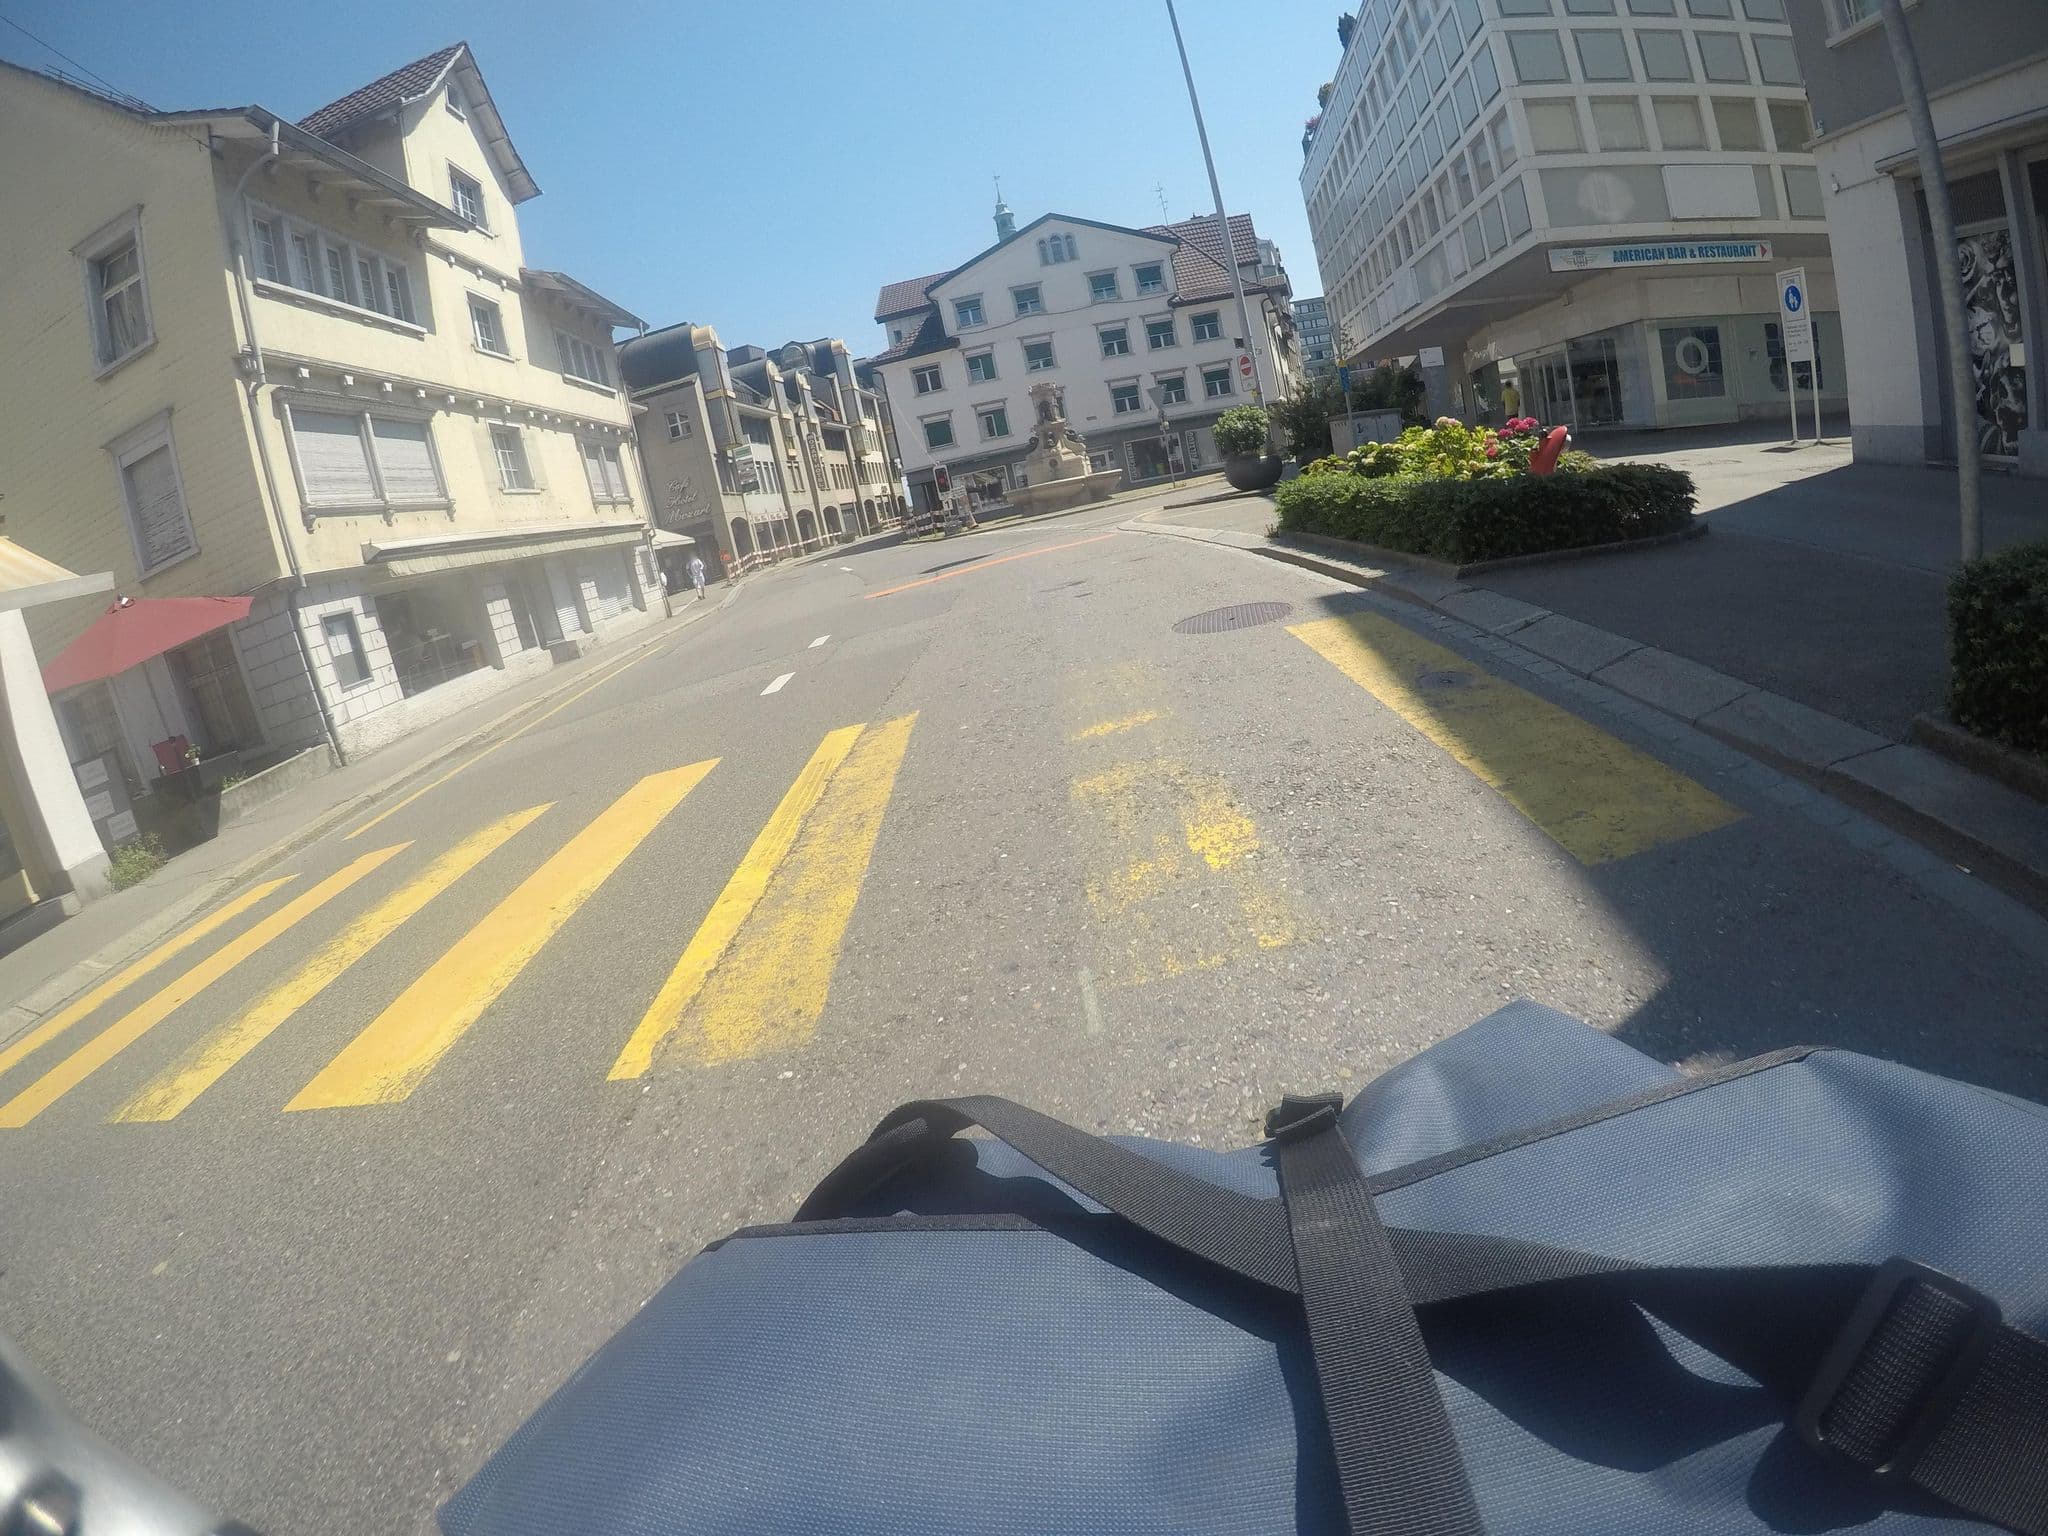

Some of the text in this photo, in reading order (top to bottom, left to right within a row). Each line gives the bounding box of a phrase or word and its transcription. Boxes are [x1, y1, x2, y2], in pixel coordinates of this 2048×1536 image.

[1613, 244, 1757, 263] AMERICAN BAR & RESTAURANT
[665, 490, 697, 508] Hotel
[664, 503, 712, 524] Mozart
